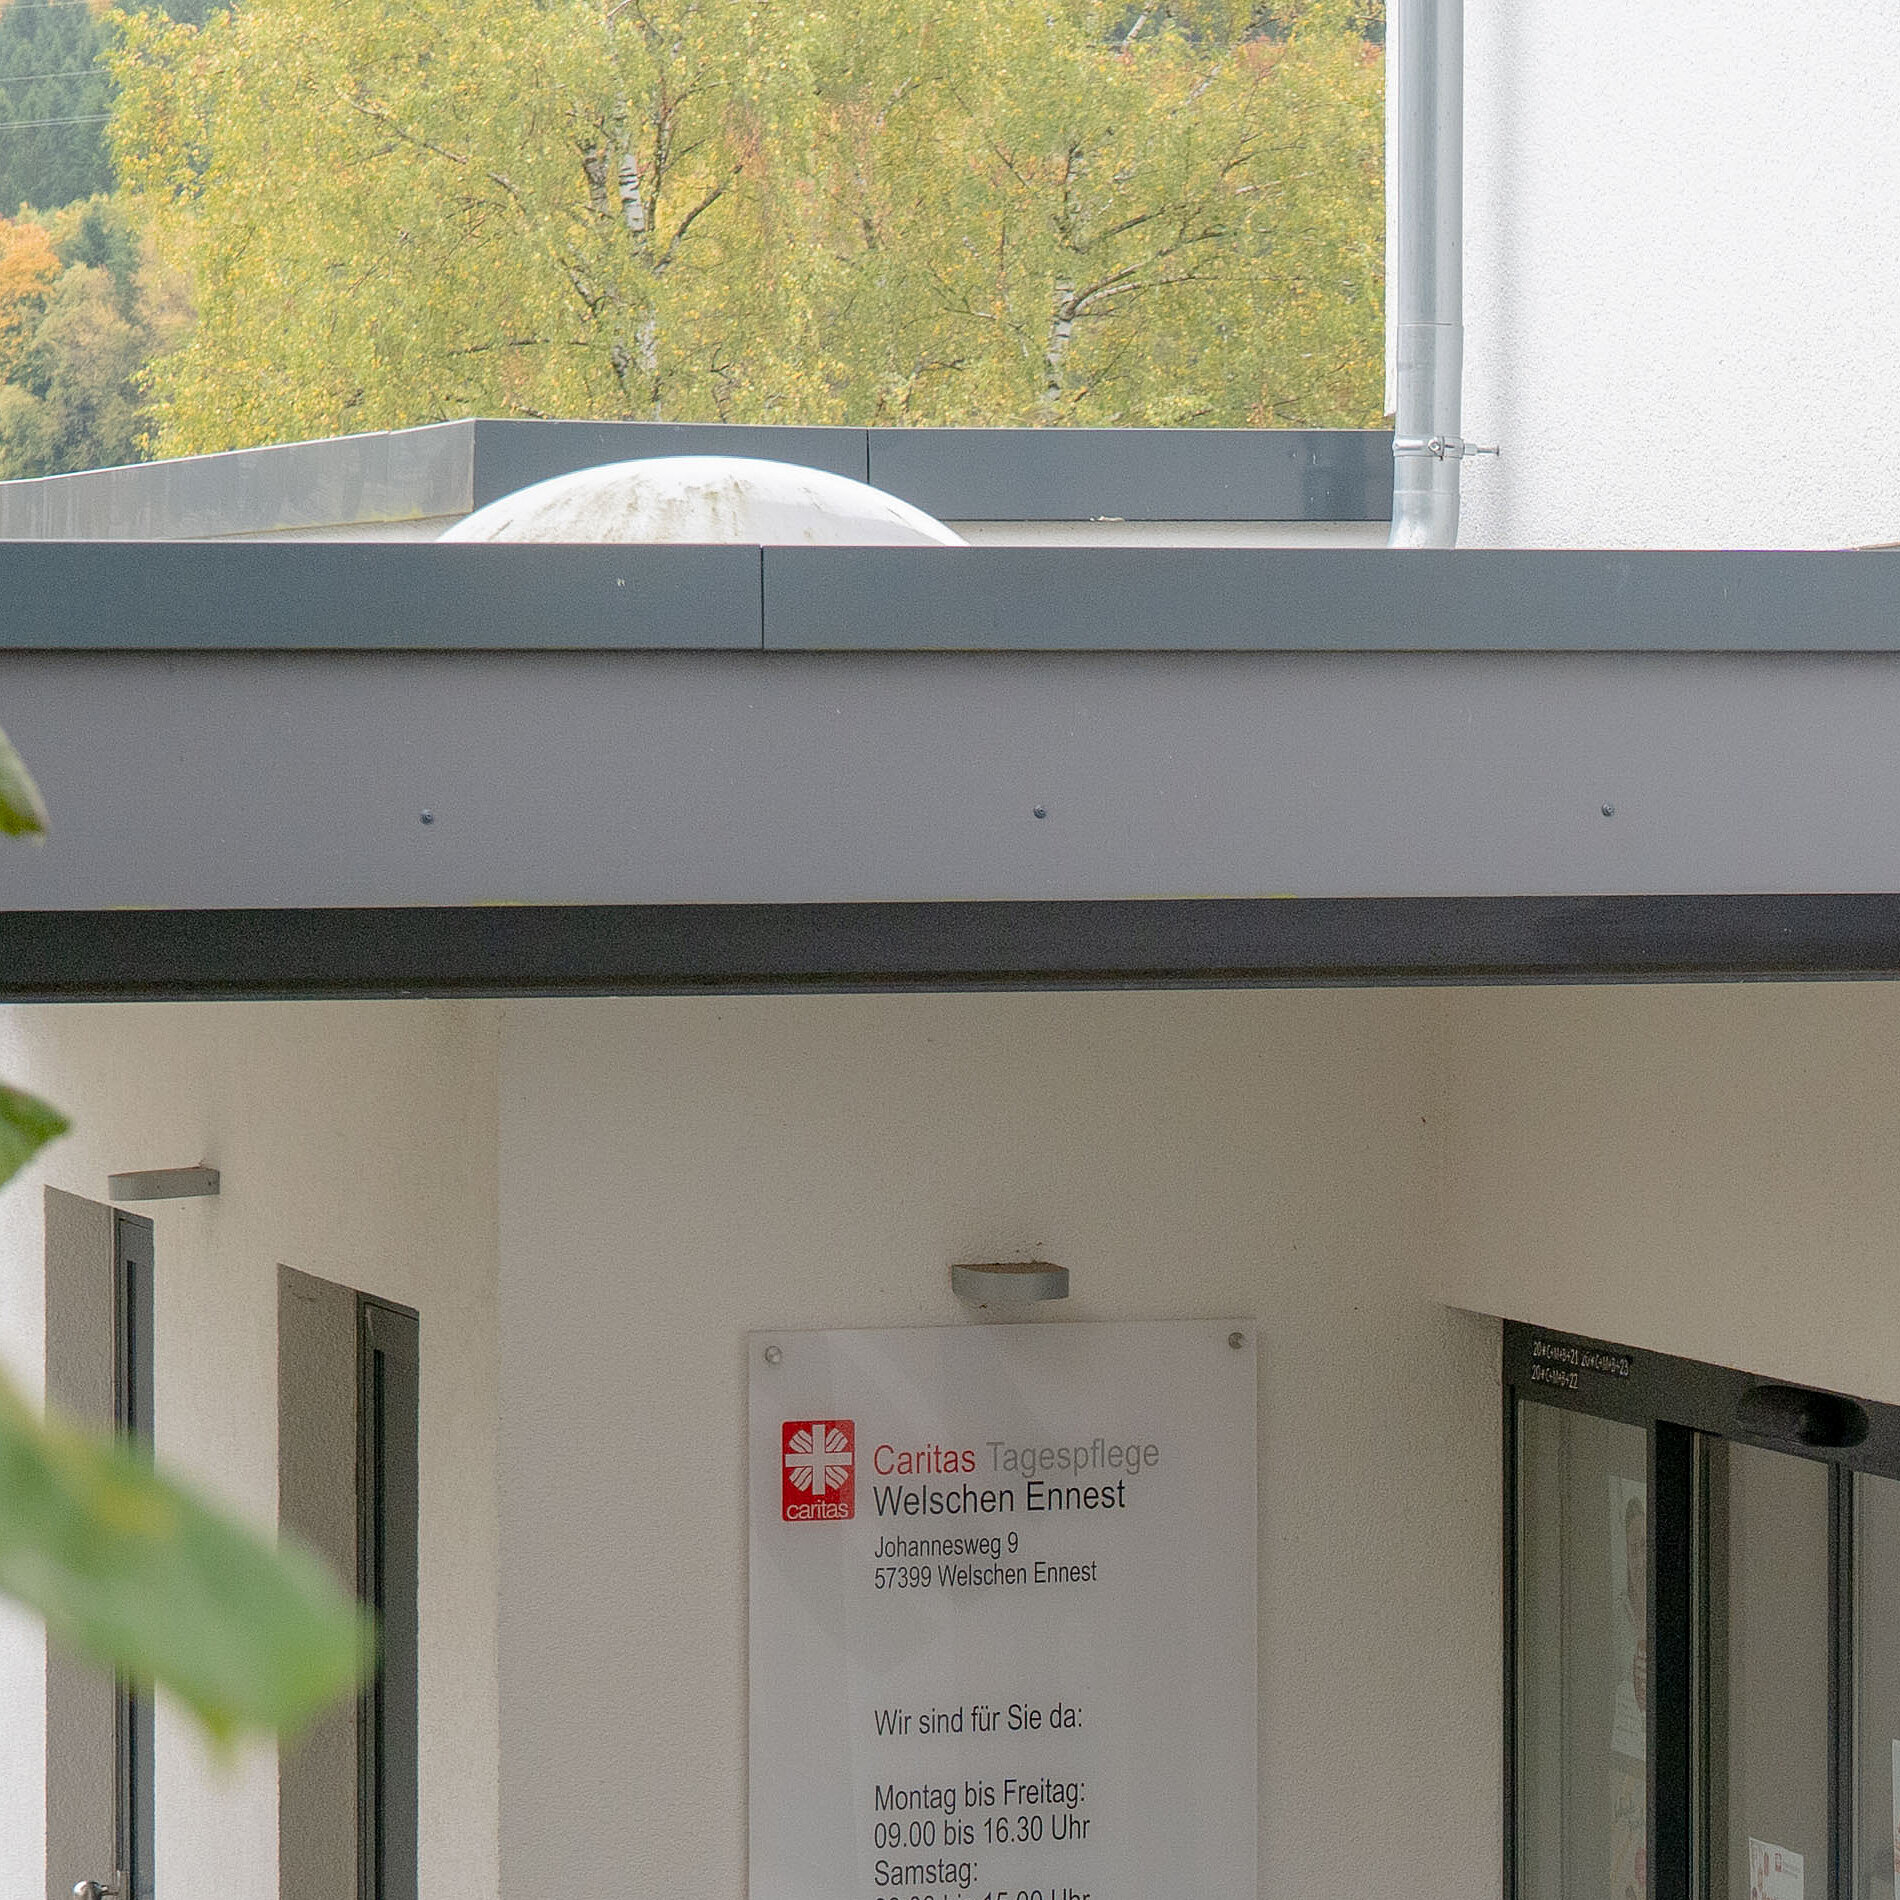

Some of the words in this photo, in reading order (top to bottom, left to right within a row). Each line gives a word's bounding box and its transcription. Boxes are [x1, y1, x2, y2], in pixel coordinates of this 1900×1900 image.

[874, 1443, 976, 1476] Caritas
[986, 1439, 1160, 1478] Tagespflege
[786, 1498, 849, 1521] caritas
[873, 1483, 1014, 1517] Welschen
[1026, 1479, 1126, 1512] Ennest
[874, 1534, 1002, 1560] Johannesweg
[1007, 1531, 1020, 1555] 9
[874, 1565, 932, 1590] 57399
[937, 1563, 1027, 1588] Welschen
[1033, 1560, 1098, 1584] Ennest
[873, 1706, 913, 1737] Wir
[918, 1704, 964, 1733] sind
[970, 1703, 1001, 1733] für
[1007, 1702, 1042, 1731] Sie
[1049, 1701, 1083, 1729] da:
[874, 1784, 957, 1816] Montag
[964, 1780, 996, 1808] bis
[1003, 1777, 1085, 1810] Freitag:
[873, 1820, 936, 1850] 09.00
[943, 1818, 975, 1846] bis
[983, 1814, 1044, 1844] 16.30
[1051, 1813, 1091, 1841] Uhr
[874, 1858, 978, 1890] Samstag:
